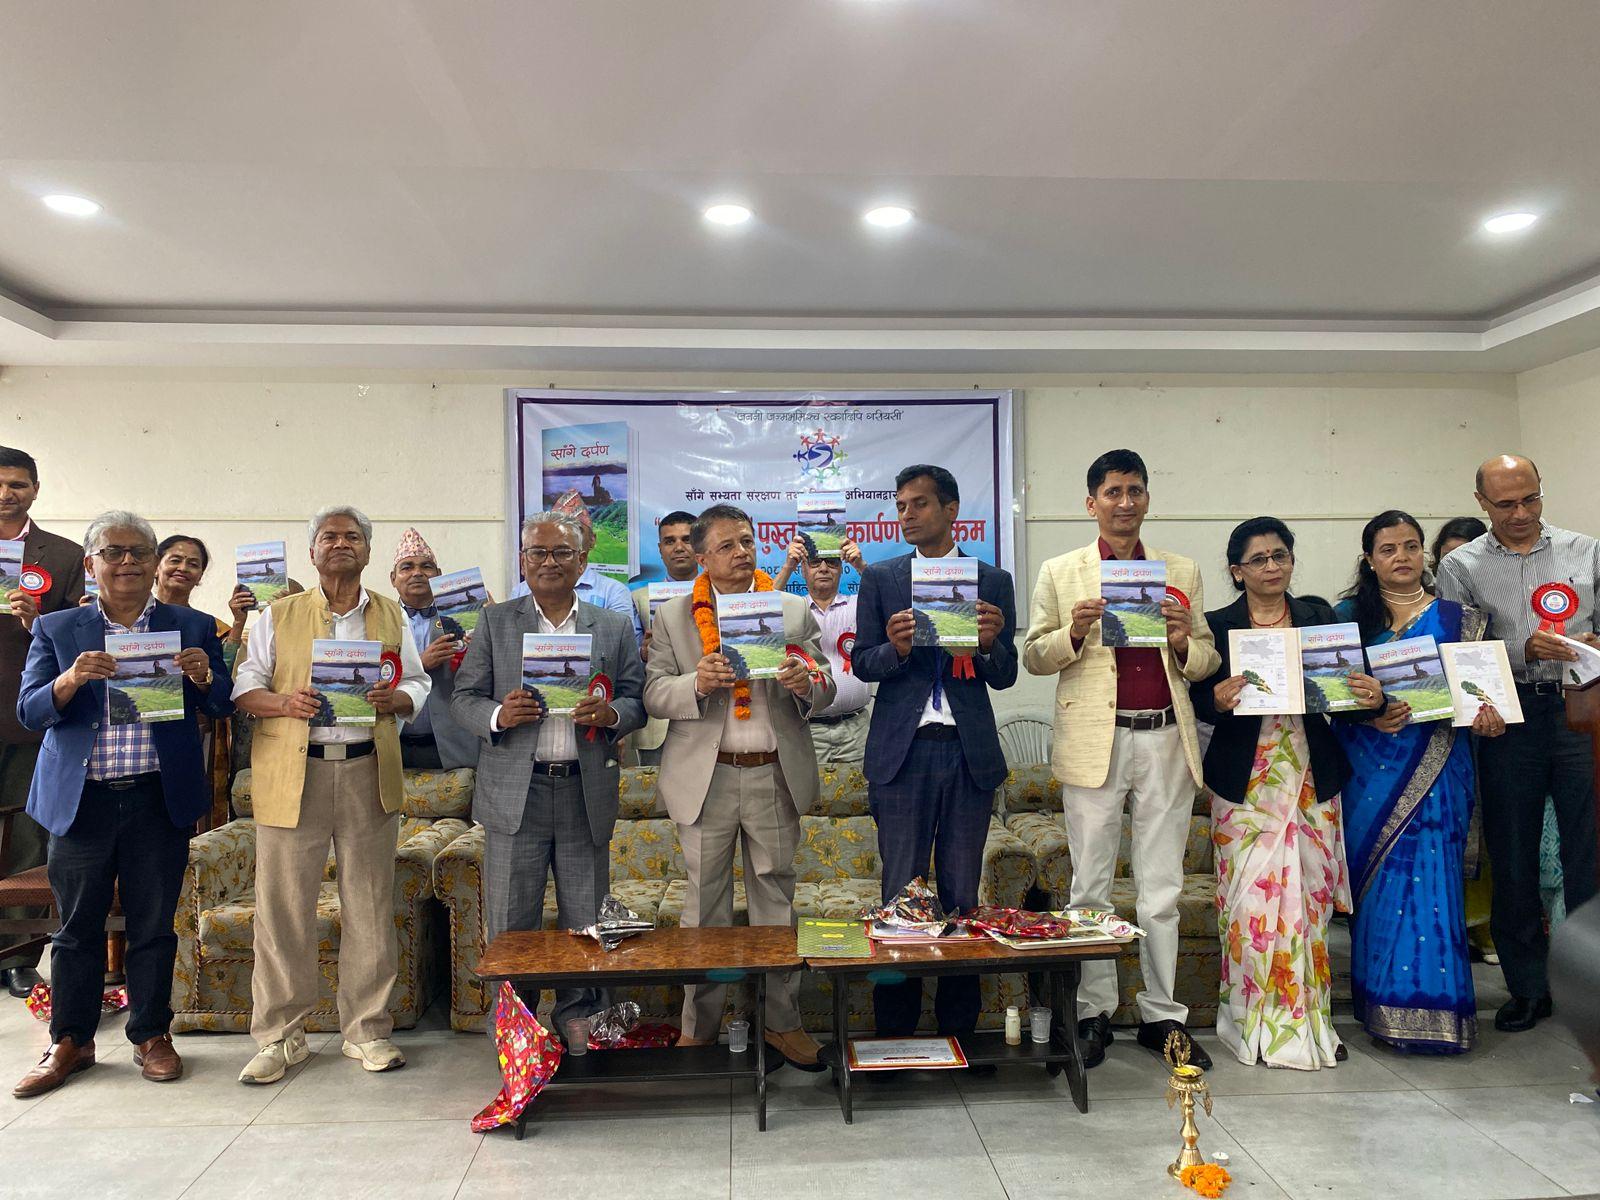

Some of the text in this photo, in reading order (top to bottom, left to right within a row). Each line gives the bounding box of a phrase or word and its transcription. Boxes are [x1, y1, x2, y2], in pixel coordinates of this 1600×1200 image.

[581, 441, 610, 459] दर्पण
[709, 491, 741, 501] सभ्यता
[746, 489, 781, 502] संरक्षण
[758, 522, 797, 554] पुस्त
